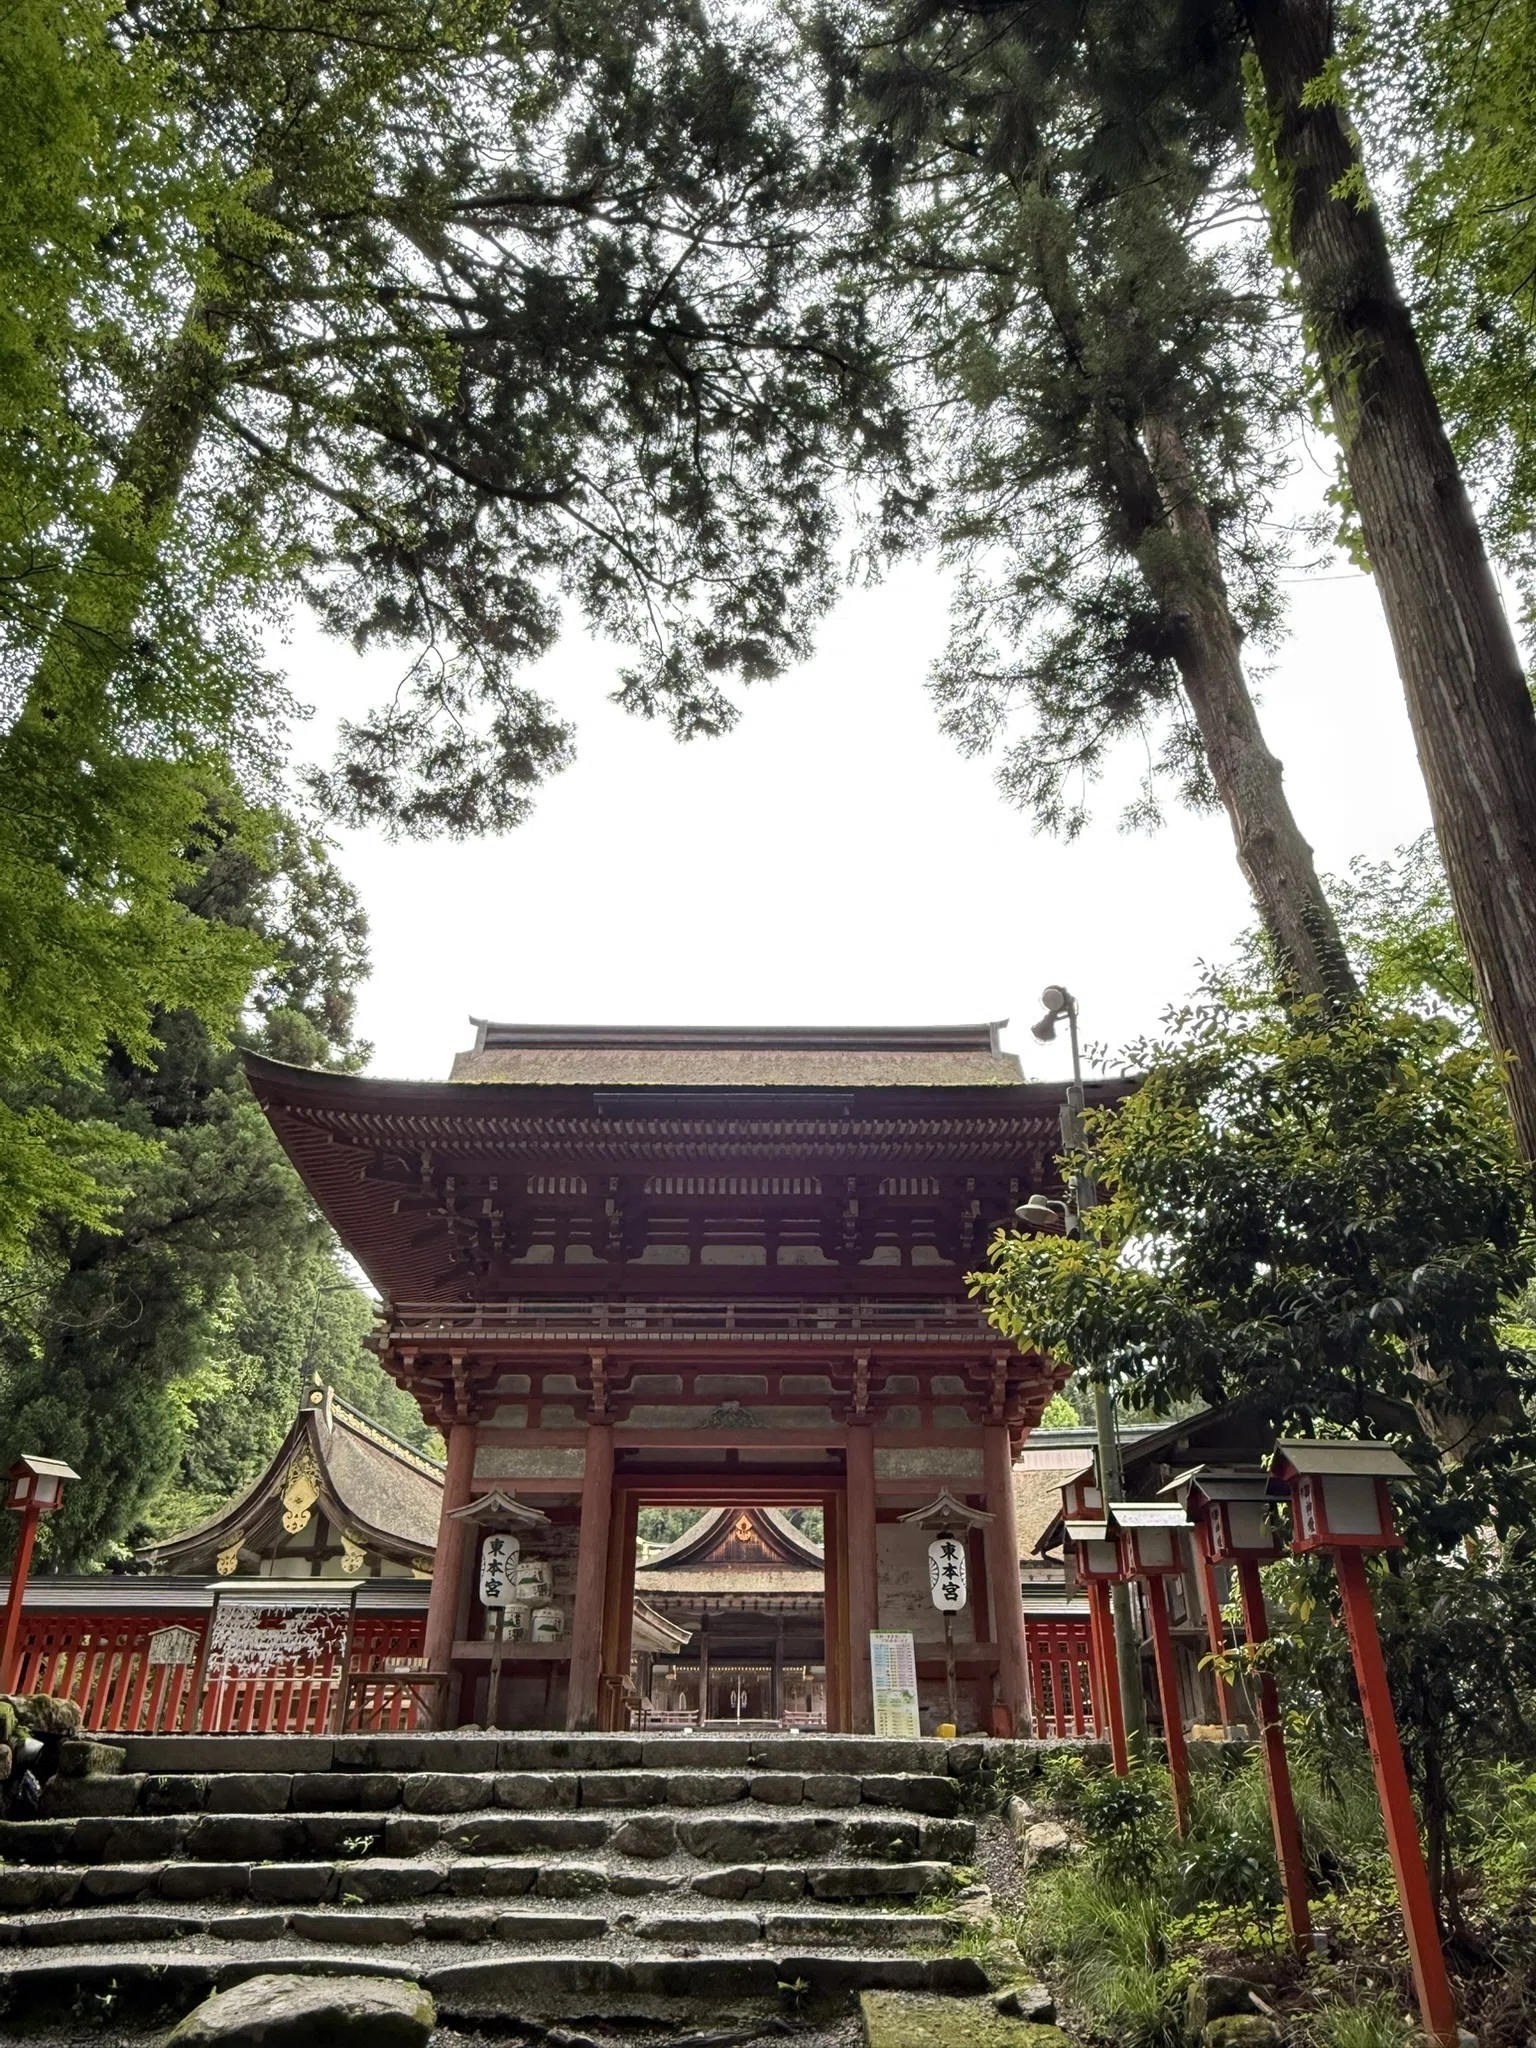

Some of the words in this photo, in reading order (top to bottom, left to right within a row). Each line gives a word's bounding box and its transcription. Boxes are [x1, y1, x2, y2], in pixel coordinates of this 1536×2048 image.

[485, 1538, 505, 1598] 東本宮
[940, 1541, 960, 1601] 東本宮
